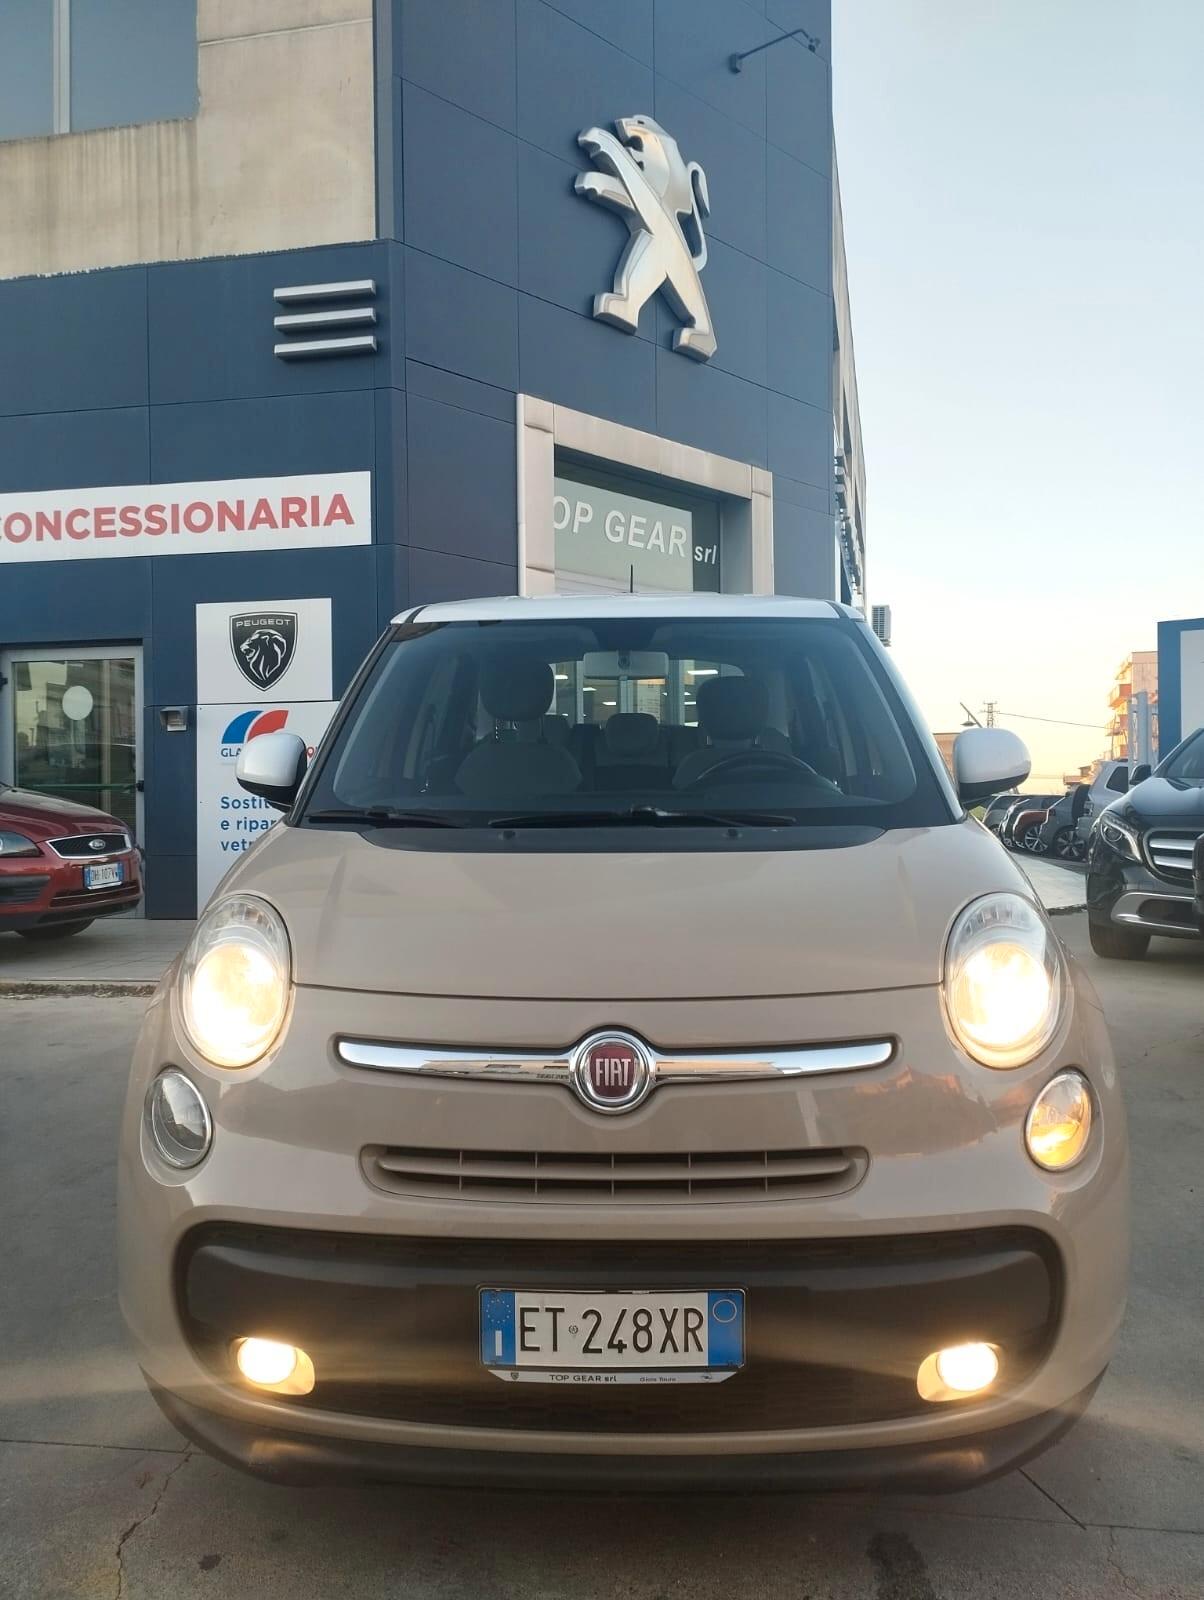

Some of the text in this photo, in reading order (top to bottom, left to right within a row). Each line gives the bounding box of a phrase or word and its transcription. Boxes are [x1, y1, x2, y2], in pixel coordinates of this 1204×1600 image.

[0, 493, 355, 544] ONCESSIONARIA
[605, 510, 687, 558] GEAR
[694, 544, 717, 565] srl
[235, 618, 291, 627] PEUGEOT
[220, 820, 230, 830] e
[595, 1058, 631, 1087] FIAT
[519, 1306, 565, 1353] ET
[582, 1308, 704, 1354] 248XR
[549, 1374, 617, 1383] TOP GEAR srl
